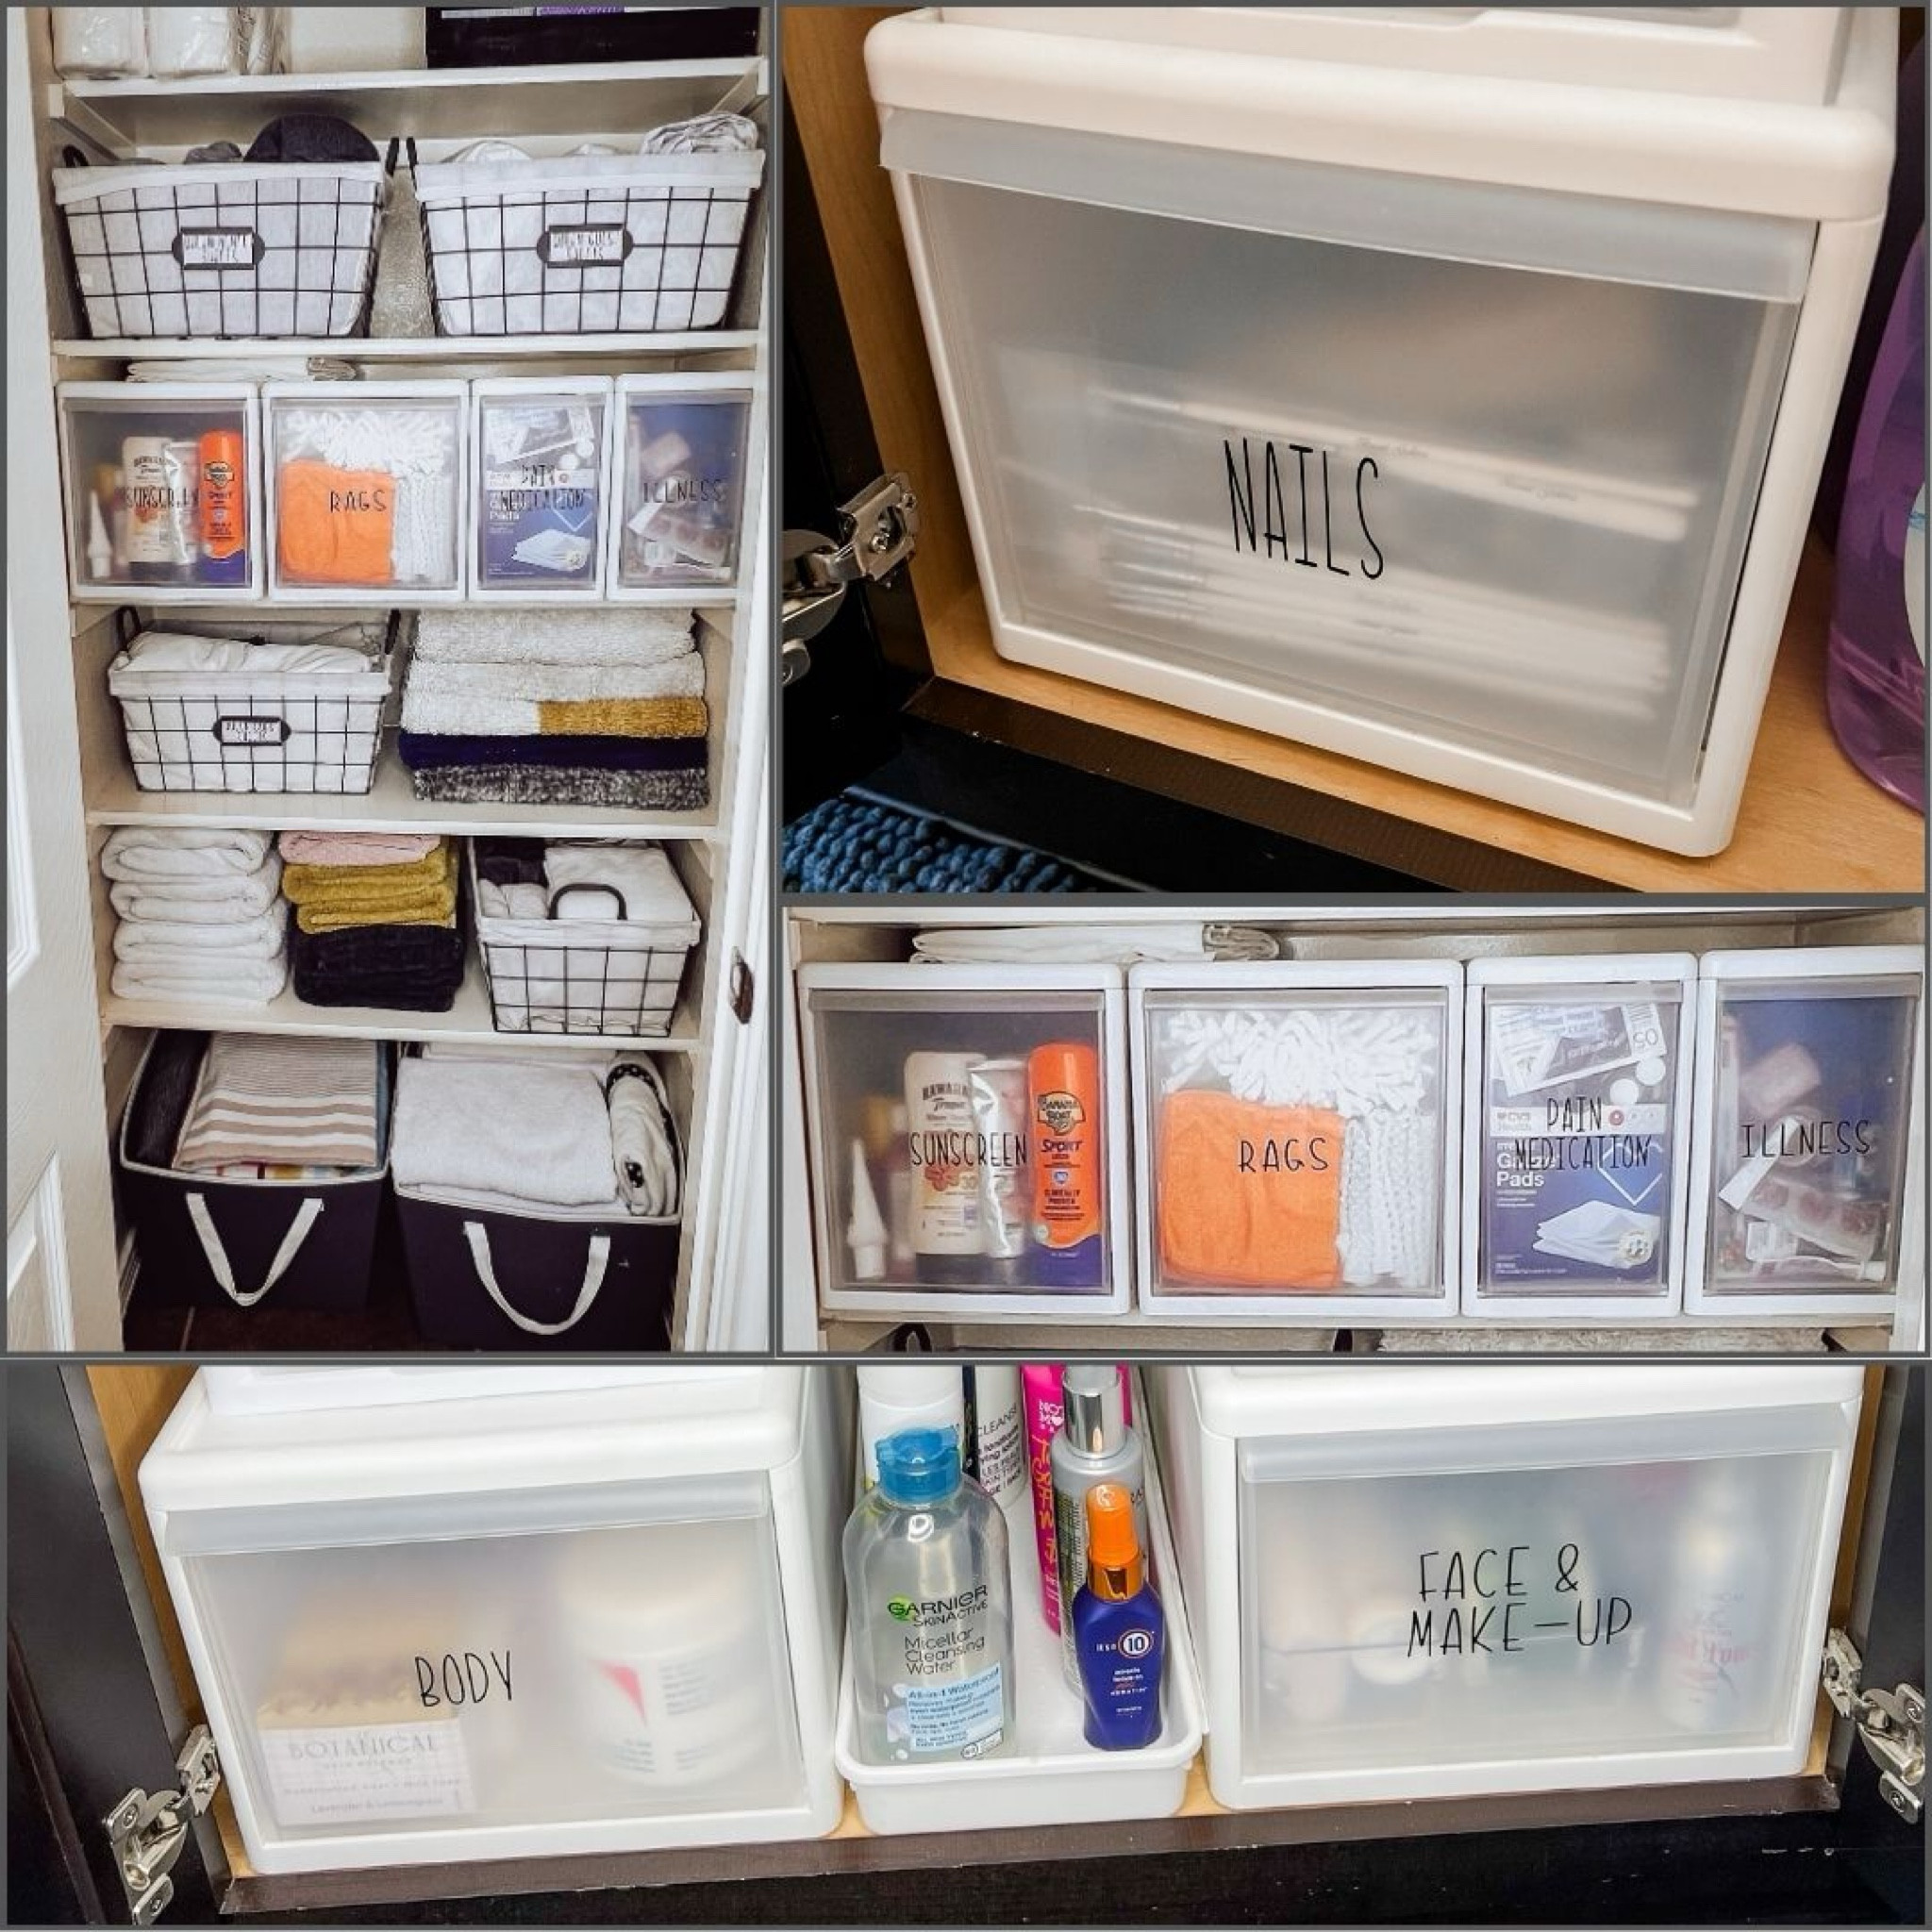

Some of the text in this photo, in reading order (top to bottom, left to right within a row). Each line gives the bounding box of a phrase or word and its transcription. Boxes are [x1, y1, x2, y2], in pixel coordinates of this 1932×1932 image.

[330, 490, 387, 513] RAGS
[1224, 437, 1383, 579] NAILS
[1547, 1095, 1602, 1133] PAIN
[910, 1131, 1026, 1167] SUNSCREEN
[1238, 1138, 1328, 1173] RAGS
[1514, 1135, 1653, 1171] MEDICATION
[1740, 1120, 1870, 1158] ILLNESS
[1496, 1171, 1544, 1187] Pads
[1419, 1543, 1579, 1602] FACE &
[888, 1585, 988, 1616] GARNIER
[905, 1627, 974, 1650] Micellar
[1128, 1636, 1145, 1651] 10
[1407, 1596, 1632, 1657] MAKE-UP
[905, 1637, 984, 1662] Cleansing
[415, 1650, 512, 1707] BODY
[907, 1660, 956, 1675] Water
